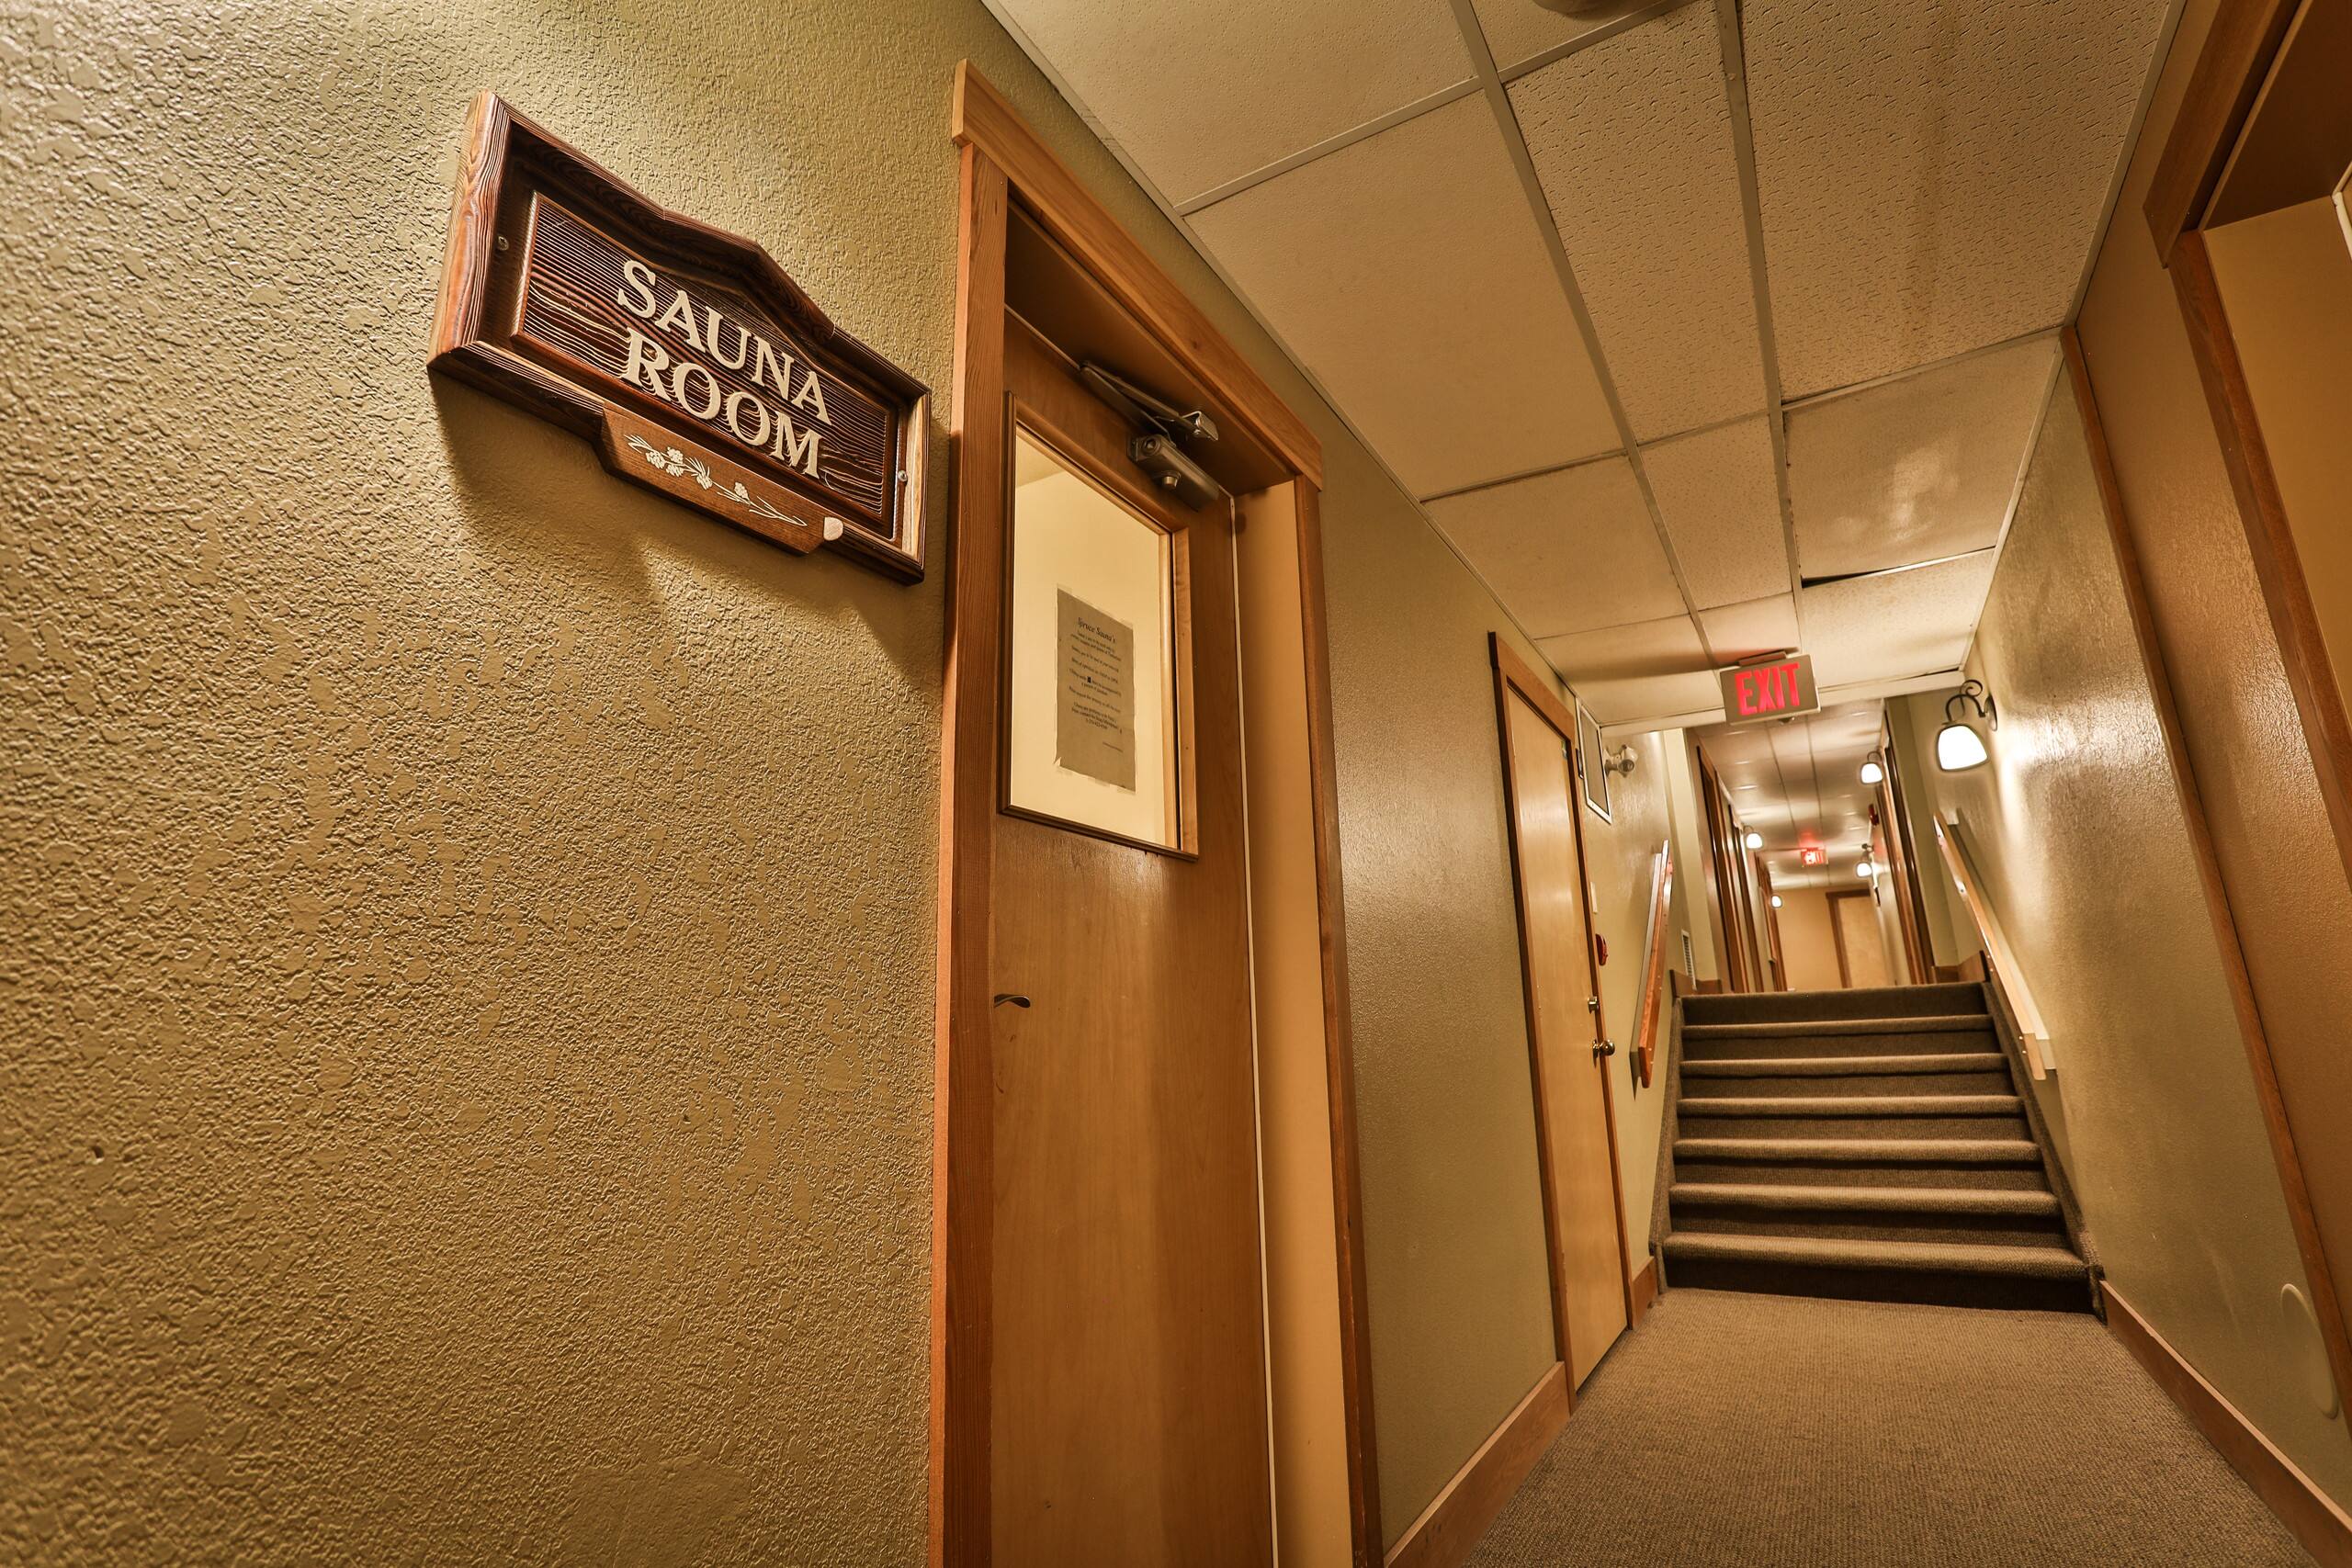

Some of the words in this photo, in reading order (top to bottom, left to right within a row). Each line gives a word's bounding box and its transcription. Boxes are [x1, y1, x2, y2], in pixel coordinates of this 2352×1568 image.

[617, 259, 832, 425] SAUNA
[620, 327, 823, 479] ROOM
[1734, 661, 1801, 716] EXIT
